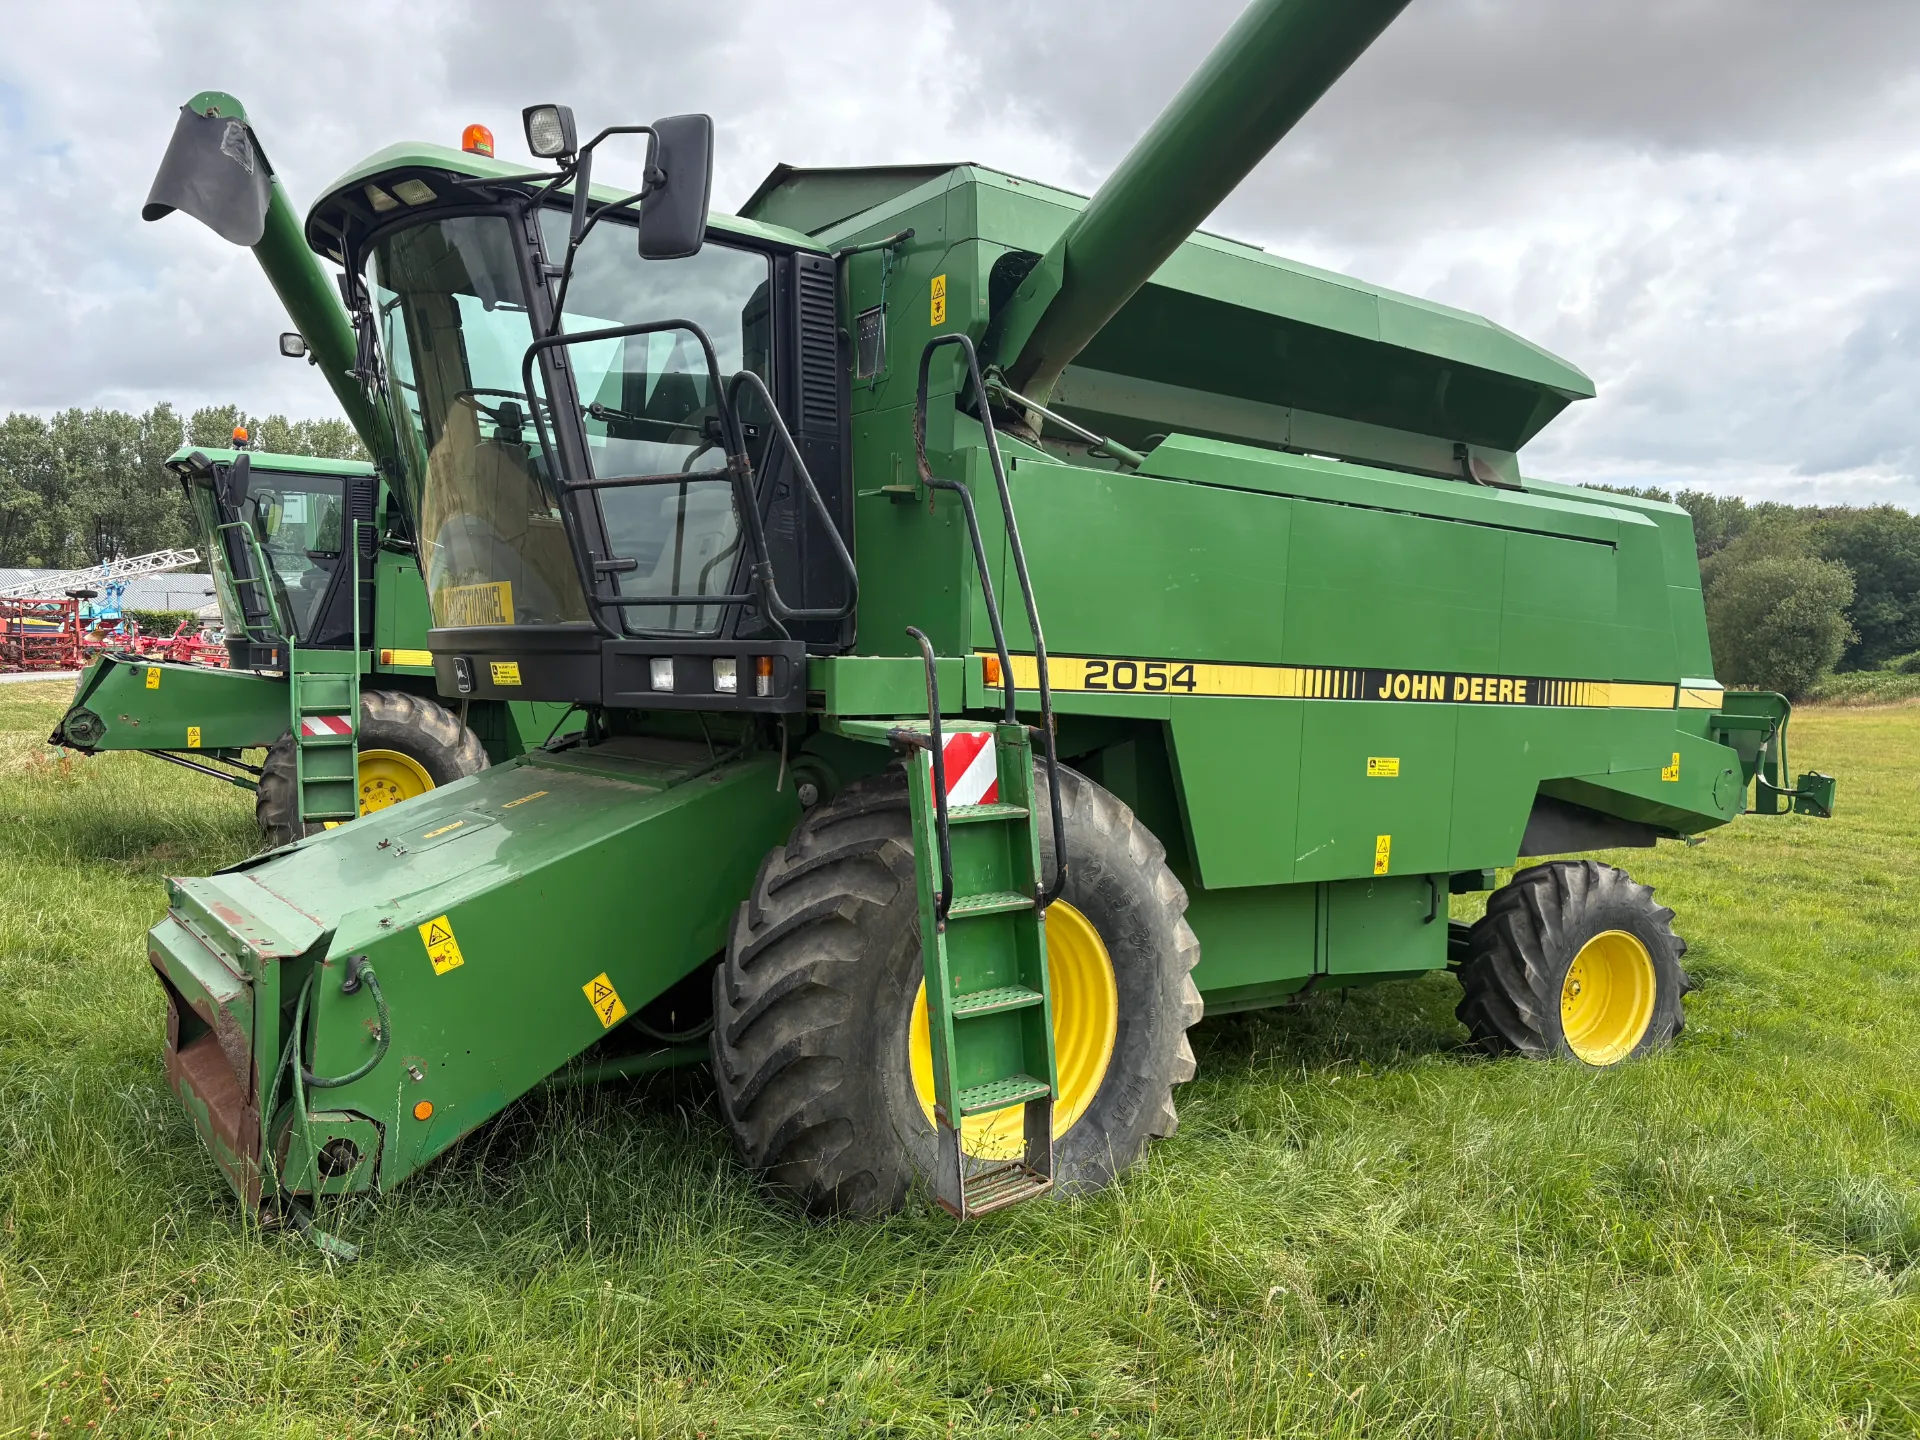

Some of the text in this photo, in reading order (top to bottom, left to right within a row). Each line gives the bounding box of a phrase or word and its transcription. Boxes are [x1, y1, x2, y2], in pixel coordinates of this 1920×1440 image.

[446, 586, 506, 627] CEPTIONNEL
[1084, 661, 1197, 692] 2054
[1378, 673, 1528, 703] JOHN DEERE
[1080, 861, 1156, 963] 24.5-32
